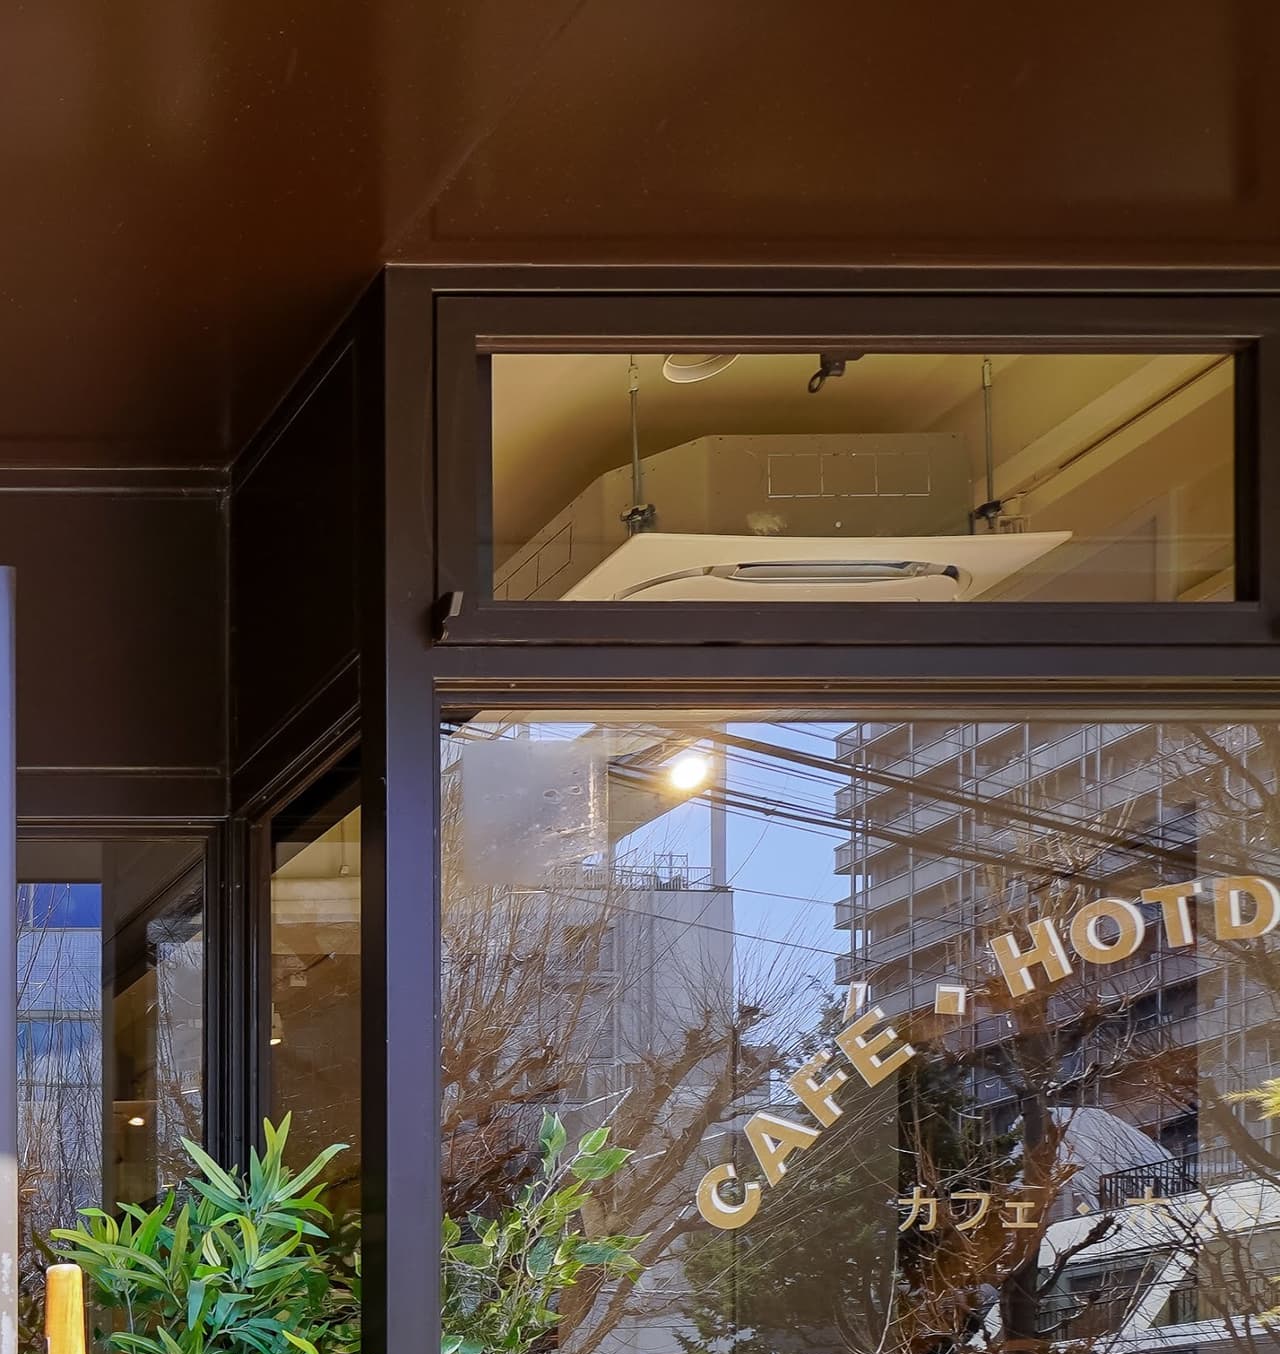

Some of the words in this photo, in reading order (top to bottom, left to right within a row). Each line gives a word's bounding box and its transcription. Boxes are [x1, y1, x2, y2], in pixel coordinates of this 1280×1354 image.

[696, 981, 916, 1231] CAFÉ
[897, 1185, 1039, 1233] カフェ
